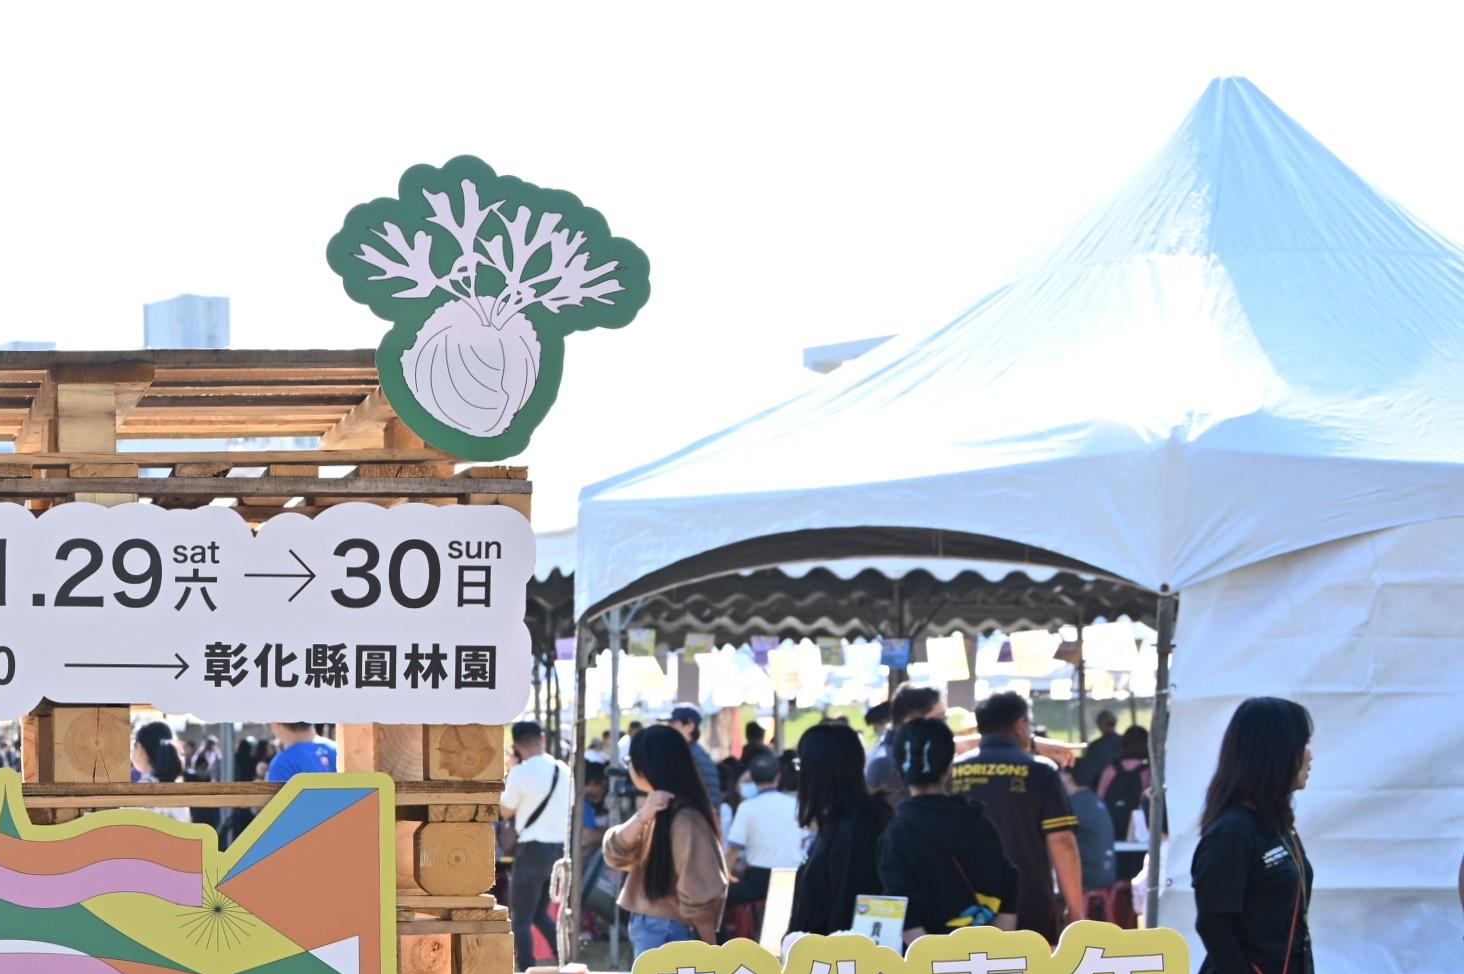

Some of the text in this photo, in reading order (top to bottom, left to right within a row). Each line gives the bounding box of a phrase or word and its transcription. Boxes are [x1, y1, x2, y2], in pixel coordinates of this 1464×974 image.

[172, 541, 220, 564] sat
[330, 538, 441, 609] 30
[447, 540, 502, 560] sun
[174, 564, 492, 612] 六 日
[203, 641, 497, 690] 彰化縣圓林園
[952, 764, 1029, 778] HORIZONS
